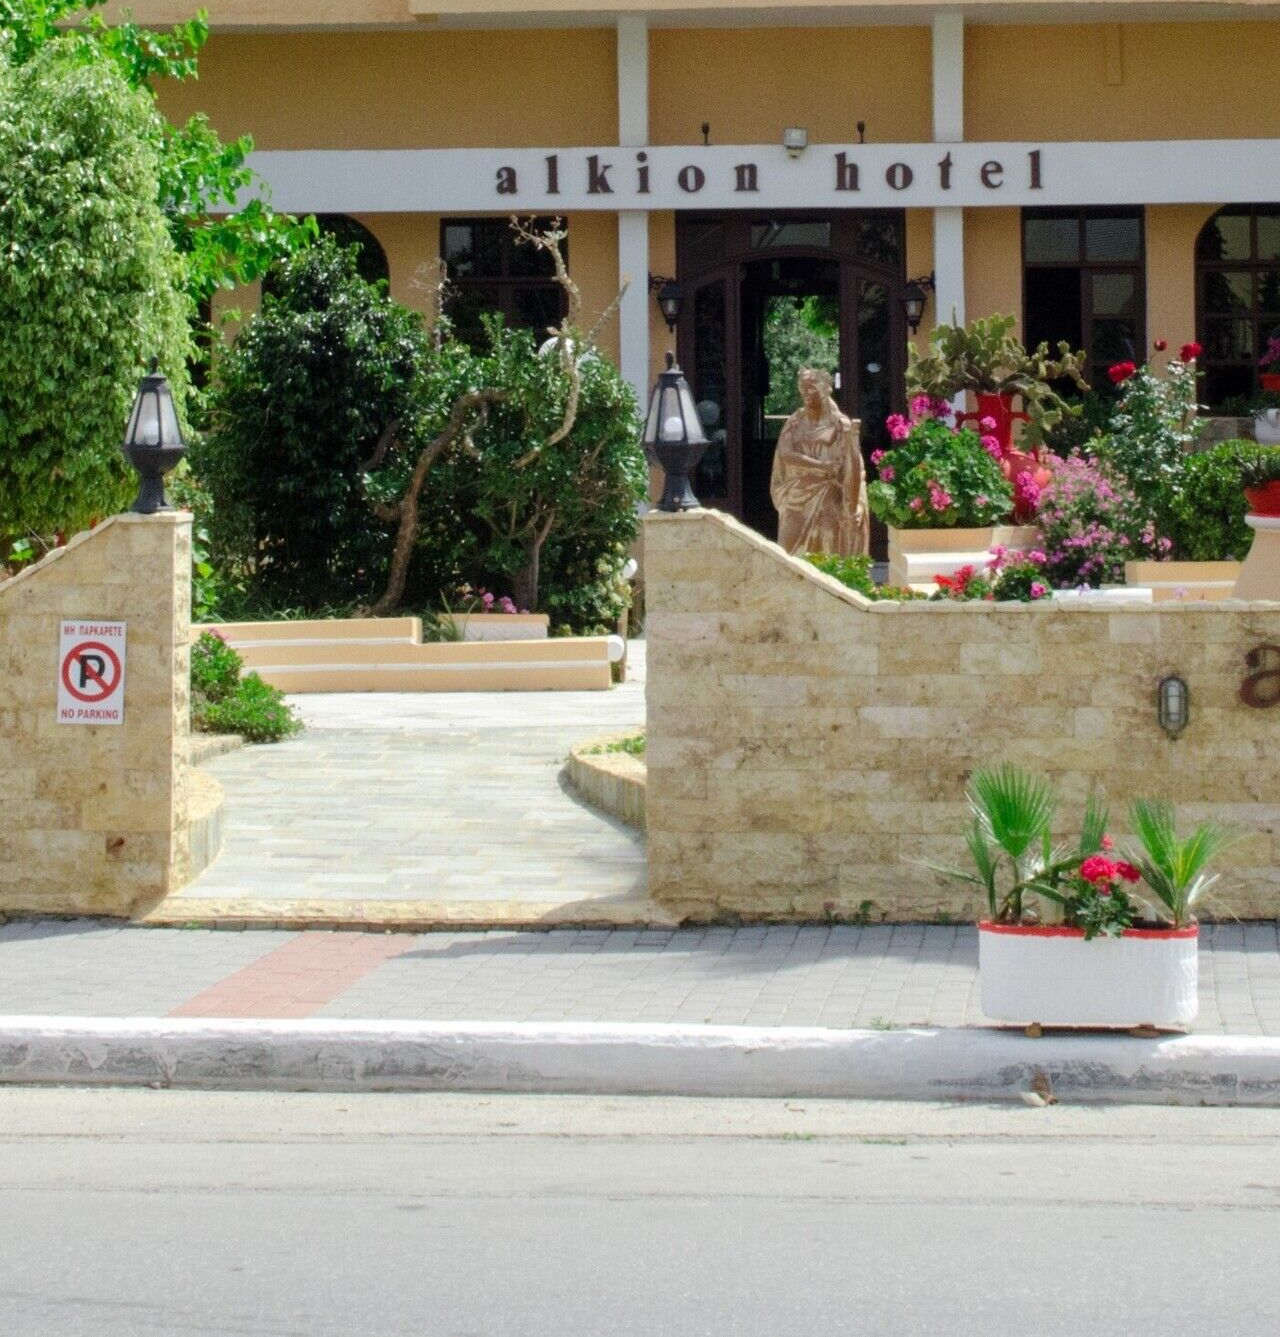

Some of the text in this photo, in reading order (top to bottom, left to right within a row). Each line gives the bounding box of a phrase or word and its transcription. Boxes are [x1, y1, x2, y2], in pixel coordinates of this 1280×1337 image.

[496, 149, 1043, 195] alkion hotel
[79, 626, 122, 636] ΠΑΡΚΑΡΕΤΕ
[61, 709, 118, 719] NO PARKING
